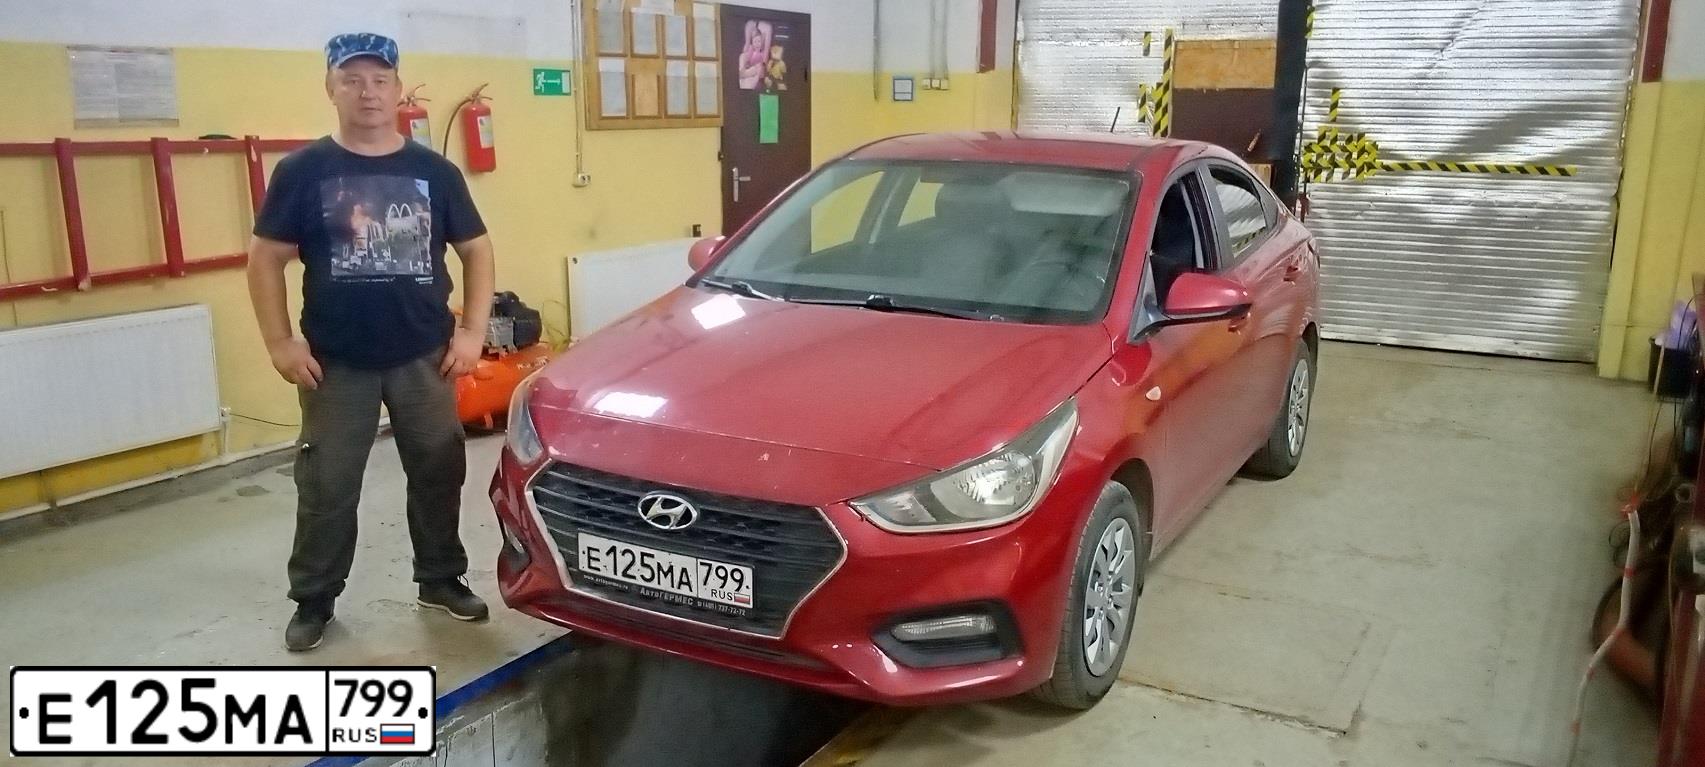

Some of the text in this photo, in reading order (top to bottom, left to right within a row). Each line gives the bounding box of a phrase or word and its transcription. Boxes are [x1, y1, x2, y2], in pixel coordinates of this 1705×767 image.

[700, 561, 745, 592] 799
[640, 588, 694, 606] АвтоГЕРМЕС
[711, 588, 733, 601] RUS
